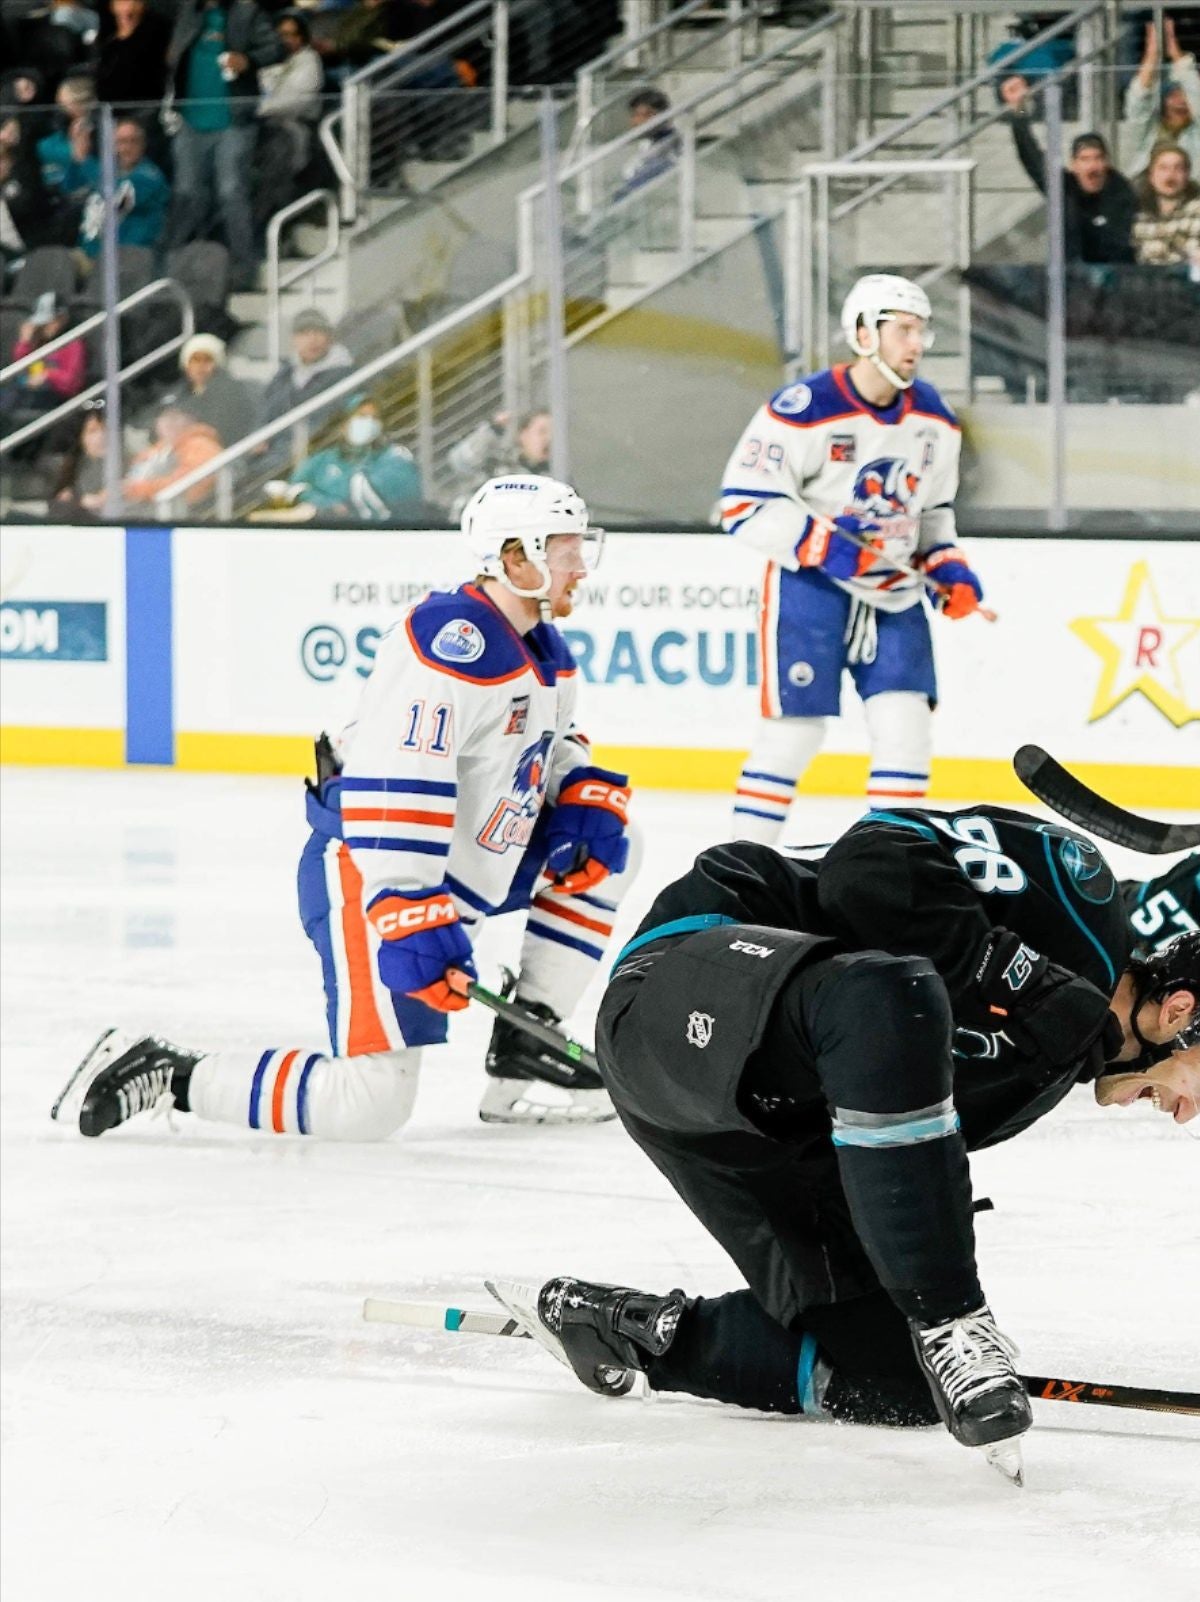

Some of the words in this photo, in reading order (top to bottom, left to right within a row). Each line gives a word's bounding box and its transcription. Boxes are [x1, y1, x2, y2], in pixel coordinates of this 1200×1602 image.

[740, 438, 785, 475] 39
[494, 483, 539, 491] WIRED
[334, 583, 379, 604] FOR
[619, 585, 672, 608] OUR
[1134, 627, 1163, 668] R
[400, 699, 453, 759] 11
[928, 815, 1028, 894] 98
[376, 902, 456, 935] CCM
[975, 943, 994, 983] SHARKS
